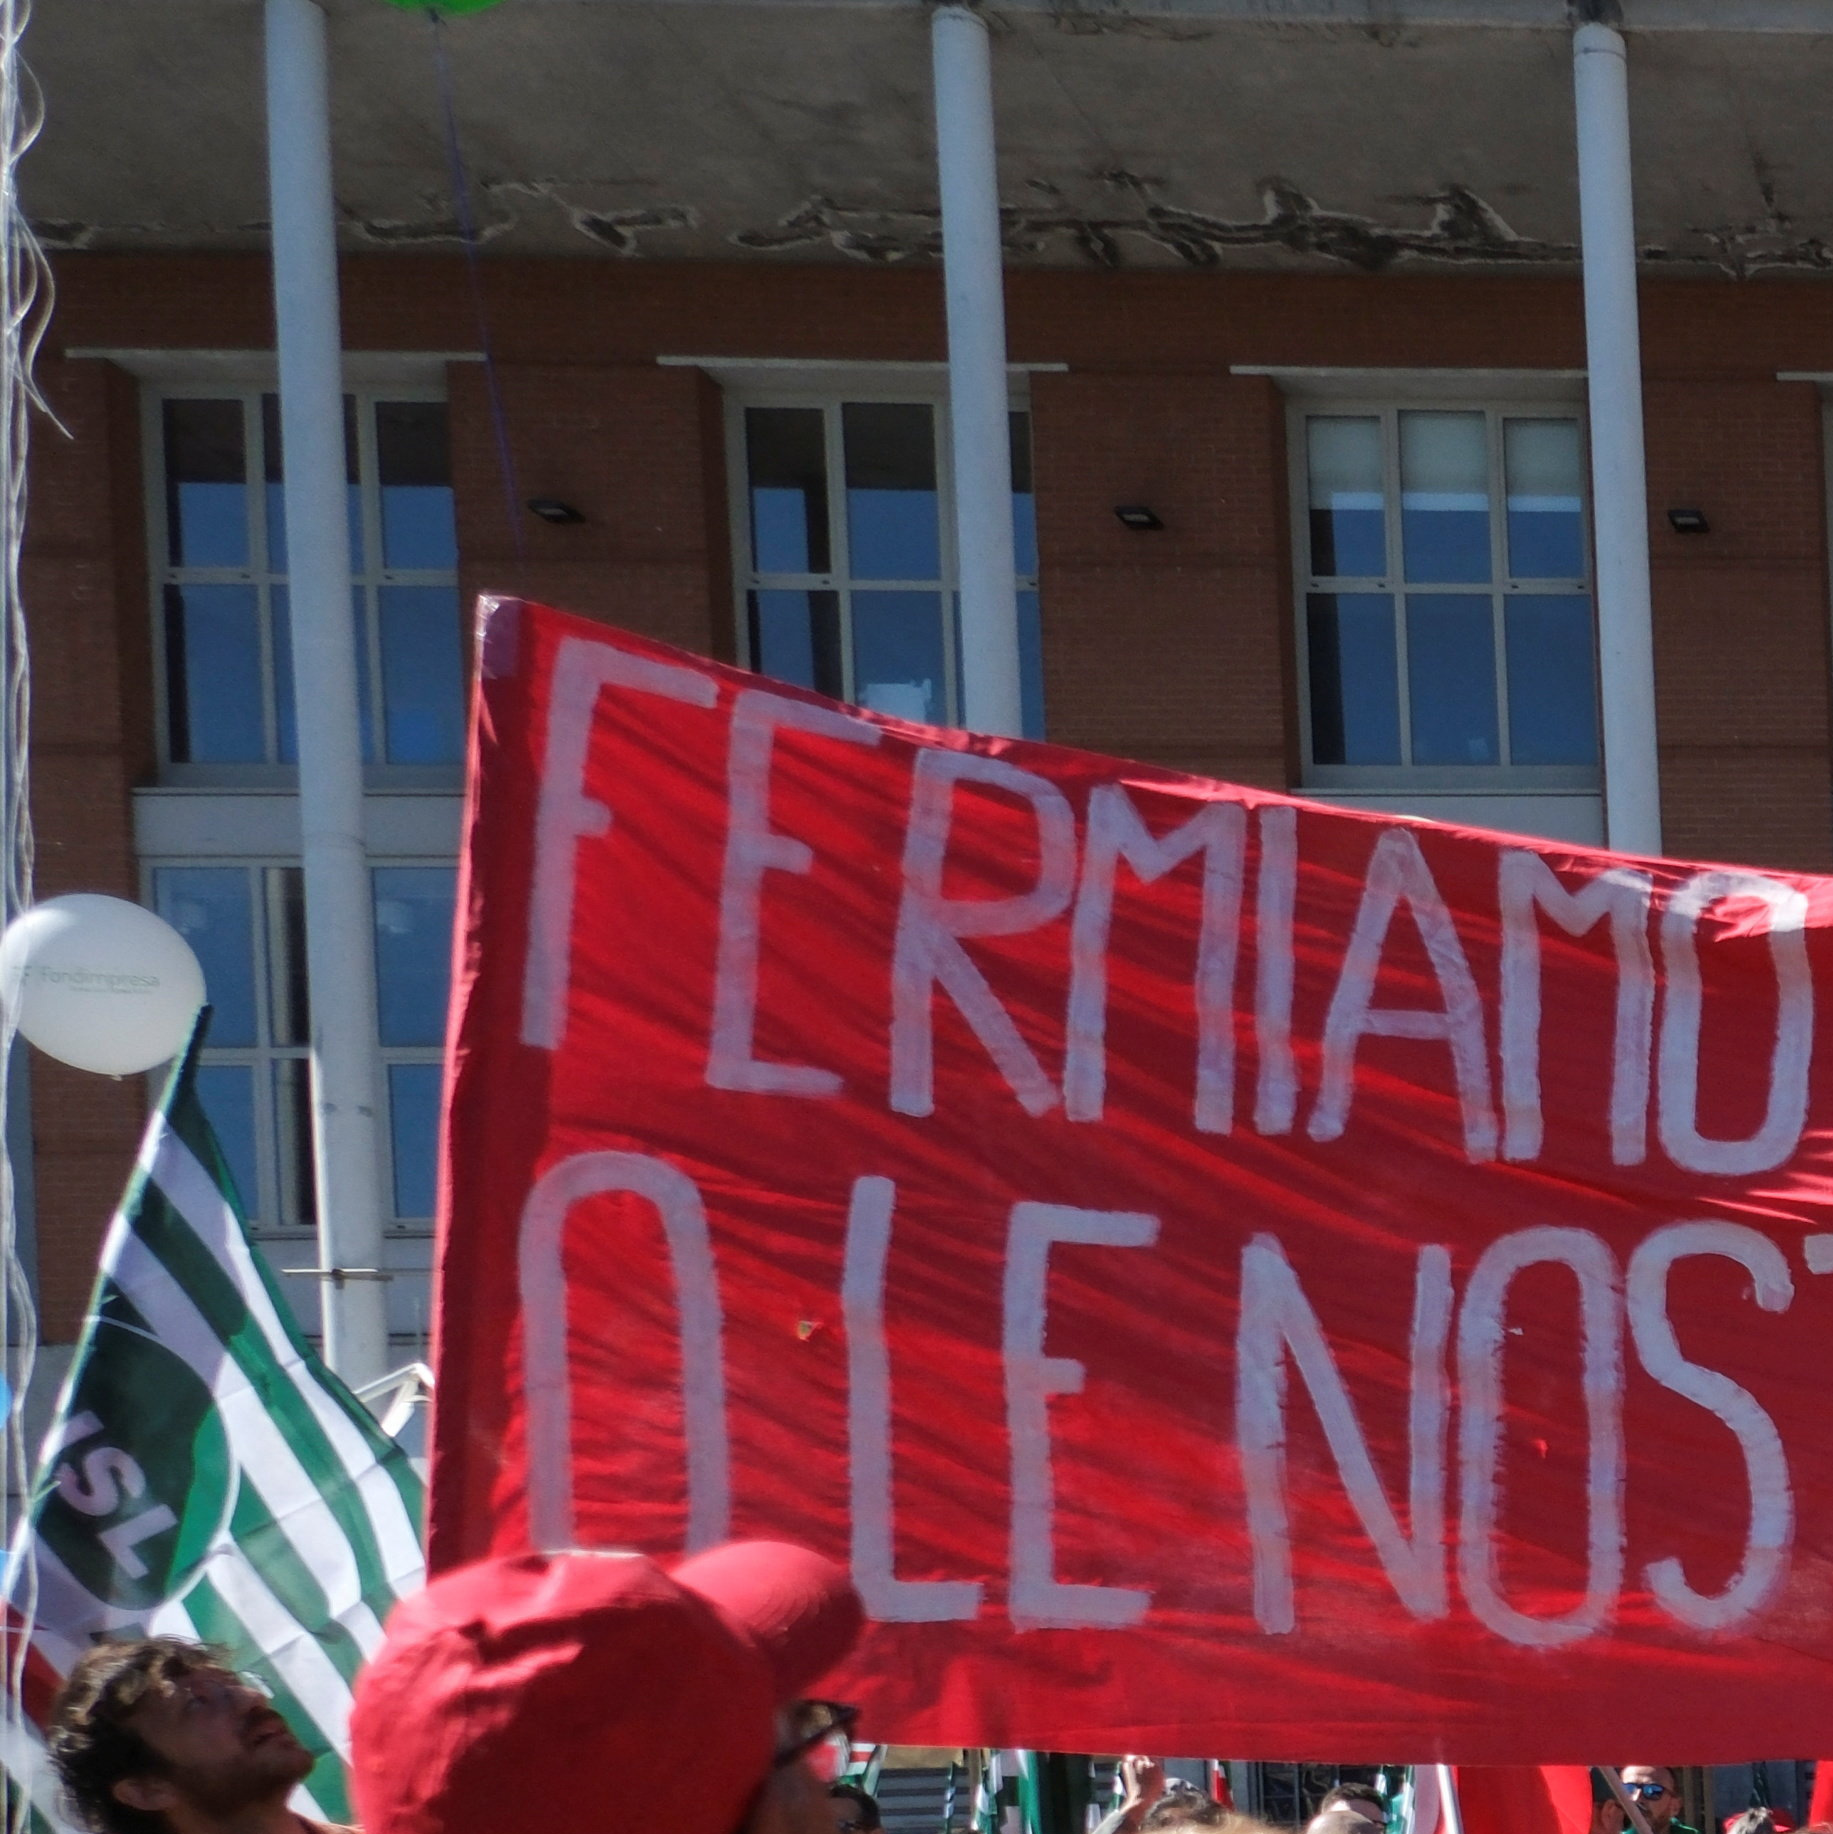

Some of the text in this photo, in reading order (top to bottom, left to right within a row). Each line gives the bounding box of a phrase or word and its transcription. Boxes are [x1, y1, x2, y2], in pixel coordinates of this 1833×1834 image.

[520, 636, 1814, 1177] FERMIAMO
[519, 1151, 730, 1553] O
[841, 1175, 1161, 1632] LE
